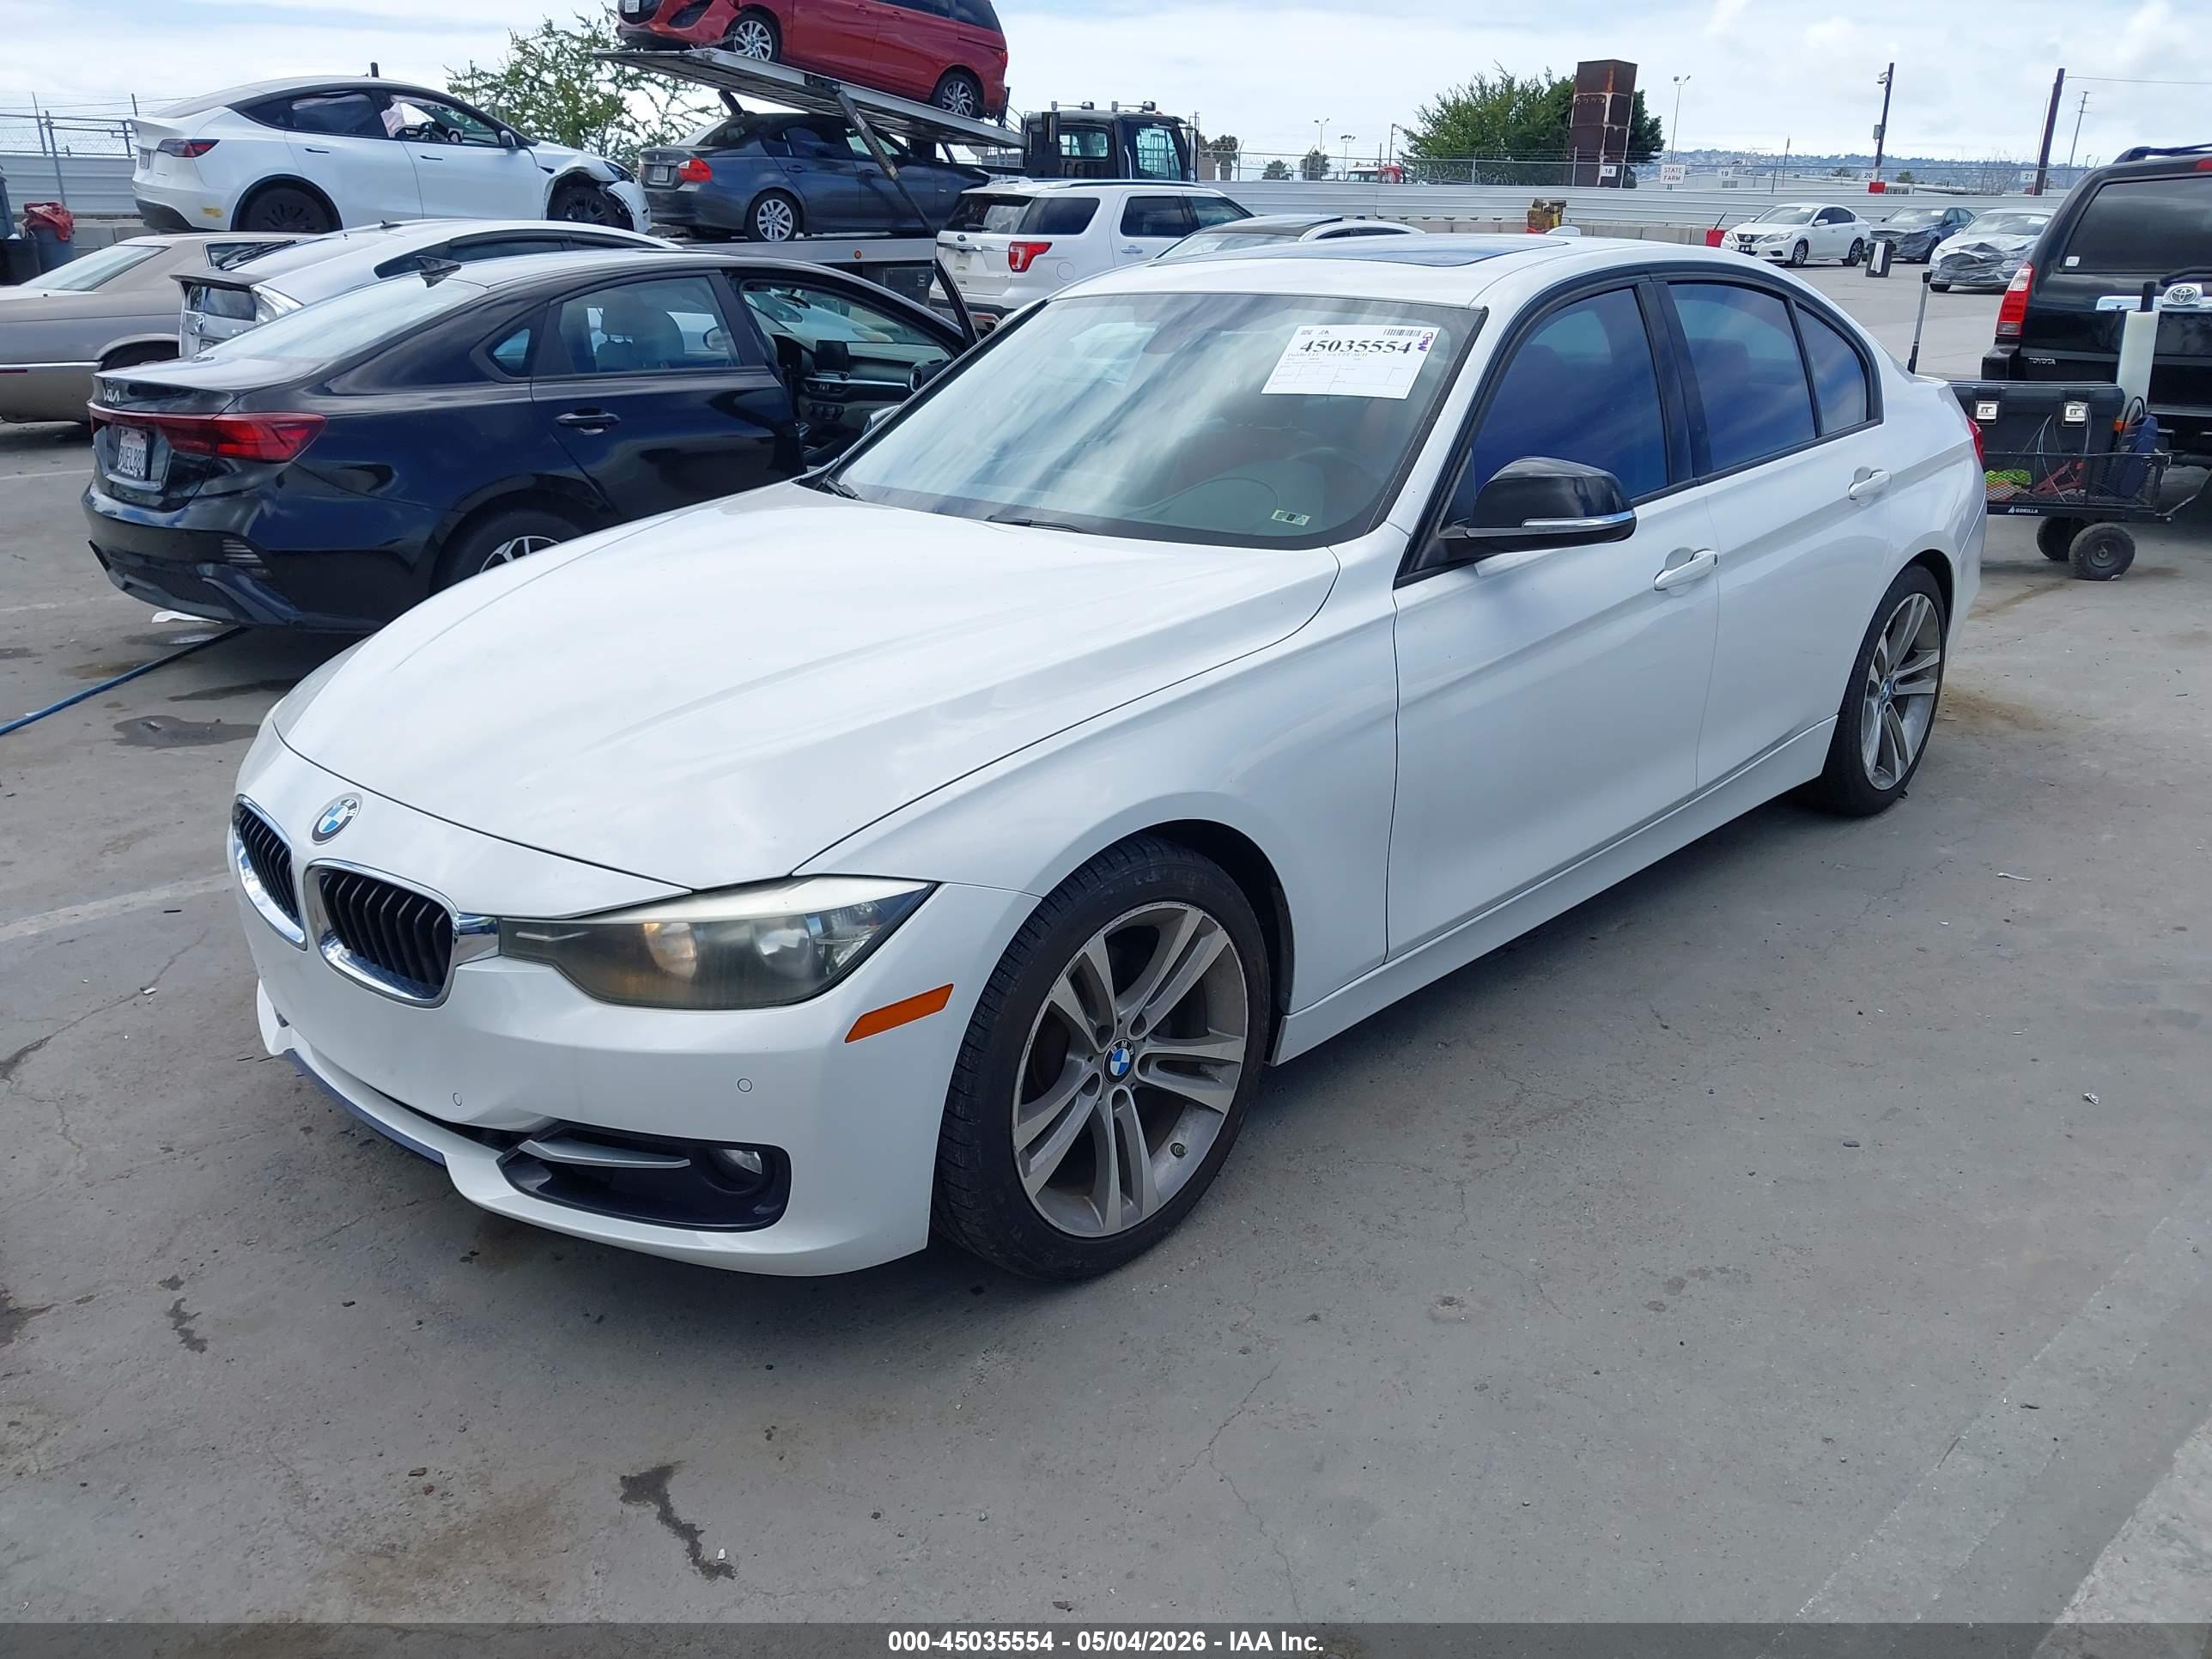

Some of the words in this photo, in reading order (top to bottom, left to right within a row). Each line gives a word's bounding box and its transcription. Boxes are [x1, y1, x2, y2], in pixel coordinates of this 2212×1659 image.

[1299, 339, 1413, 354] 45035554
[103, 388, 120, 402] KIA
[1110, 1040, 1134, 1055] BMW
